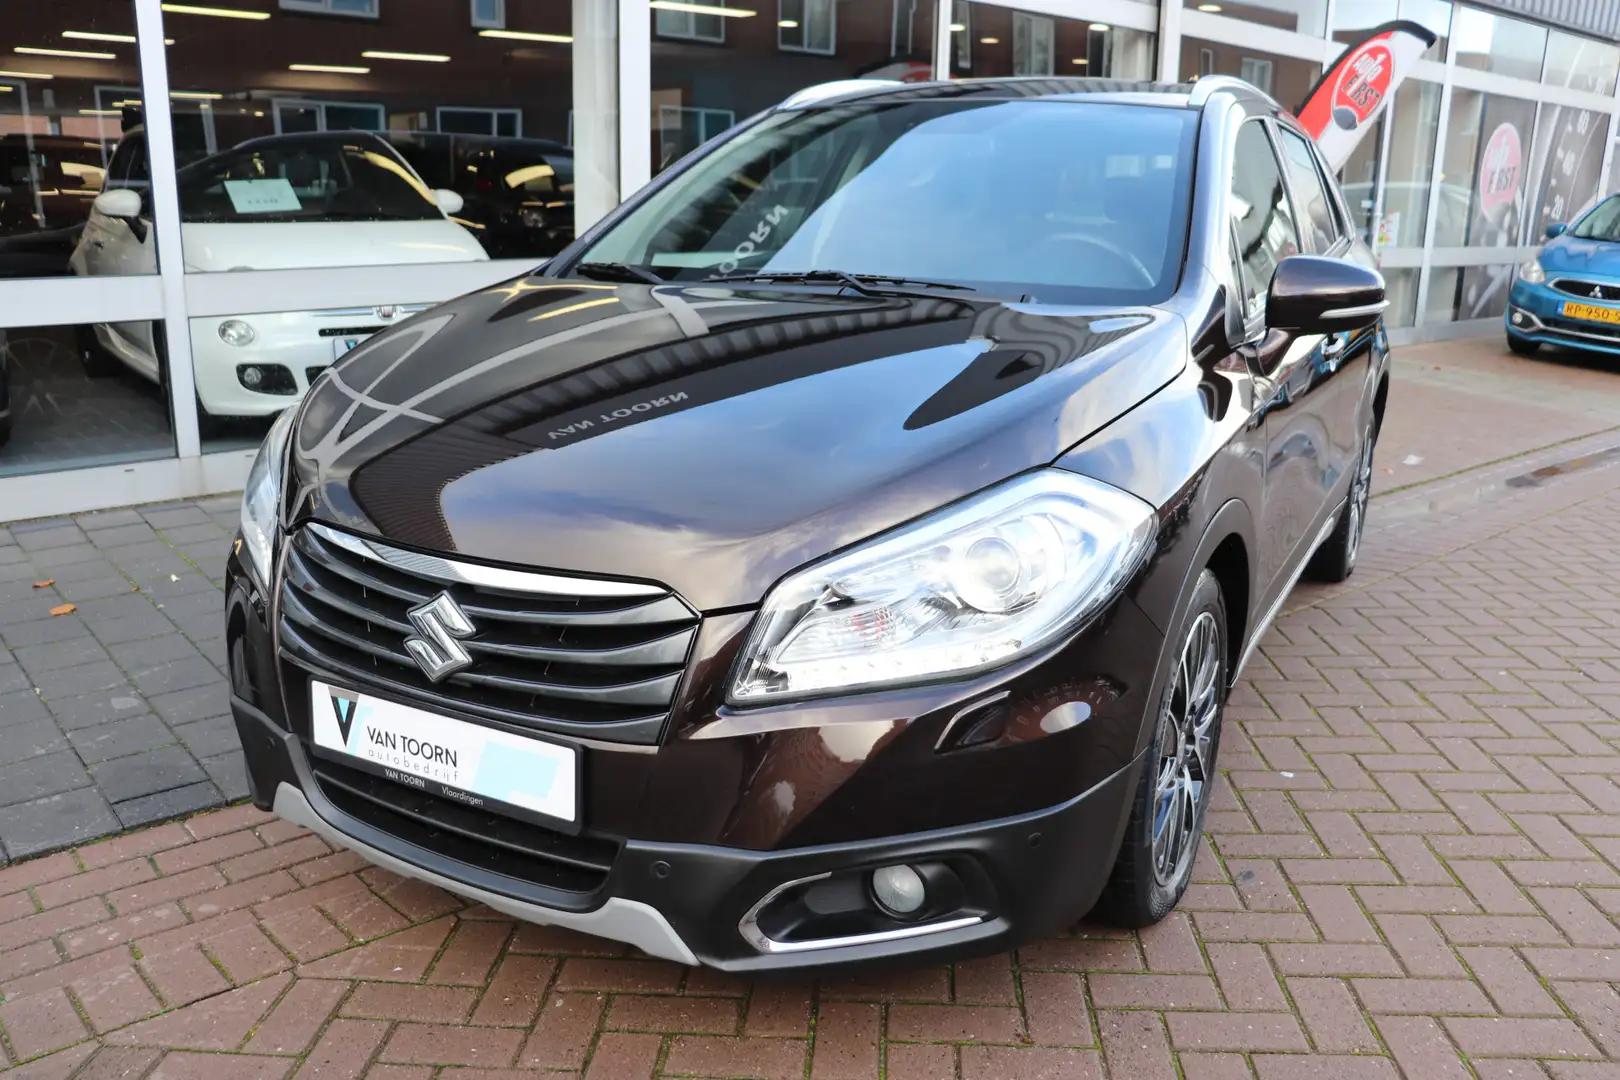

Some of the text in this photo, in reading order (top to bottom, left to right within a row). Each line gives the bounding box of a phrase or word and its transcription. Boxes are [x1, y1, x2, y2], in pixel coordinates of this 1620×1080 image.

[366, 725, 458, 768] VAN TOORN
[368, 748, 459, 783] autobedrijf
[384, 768, 484, 806] VAN TOORN Vlaardingen
